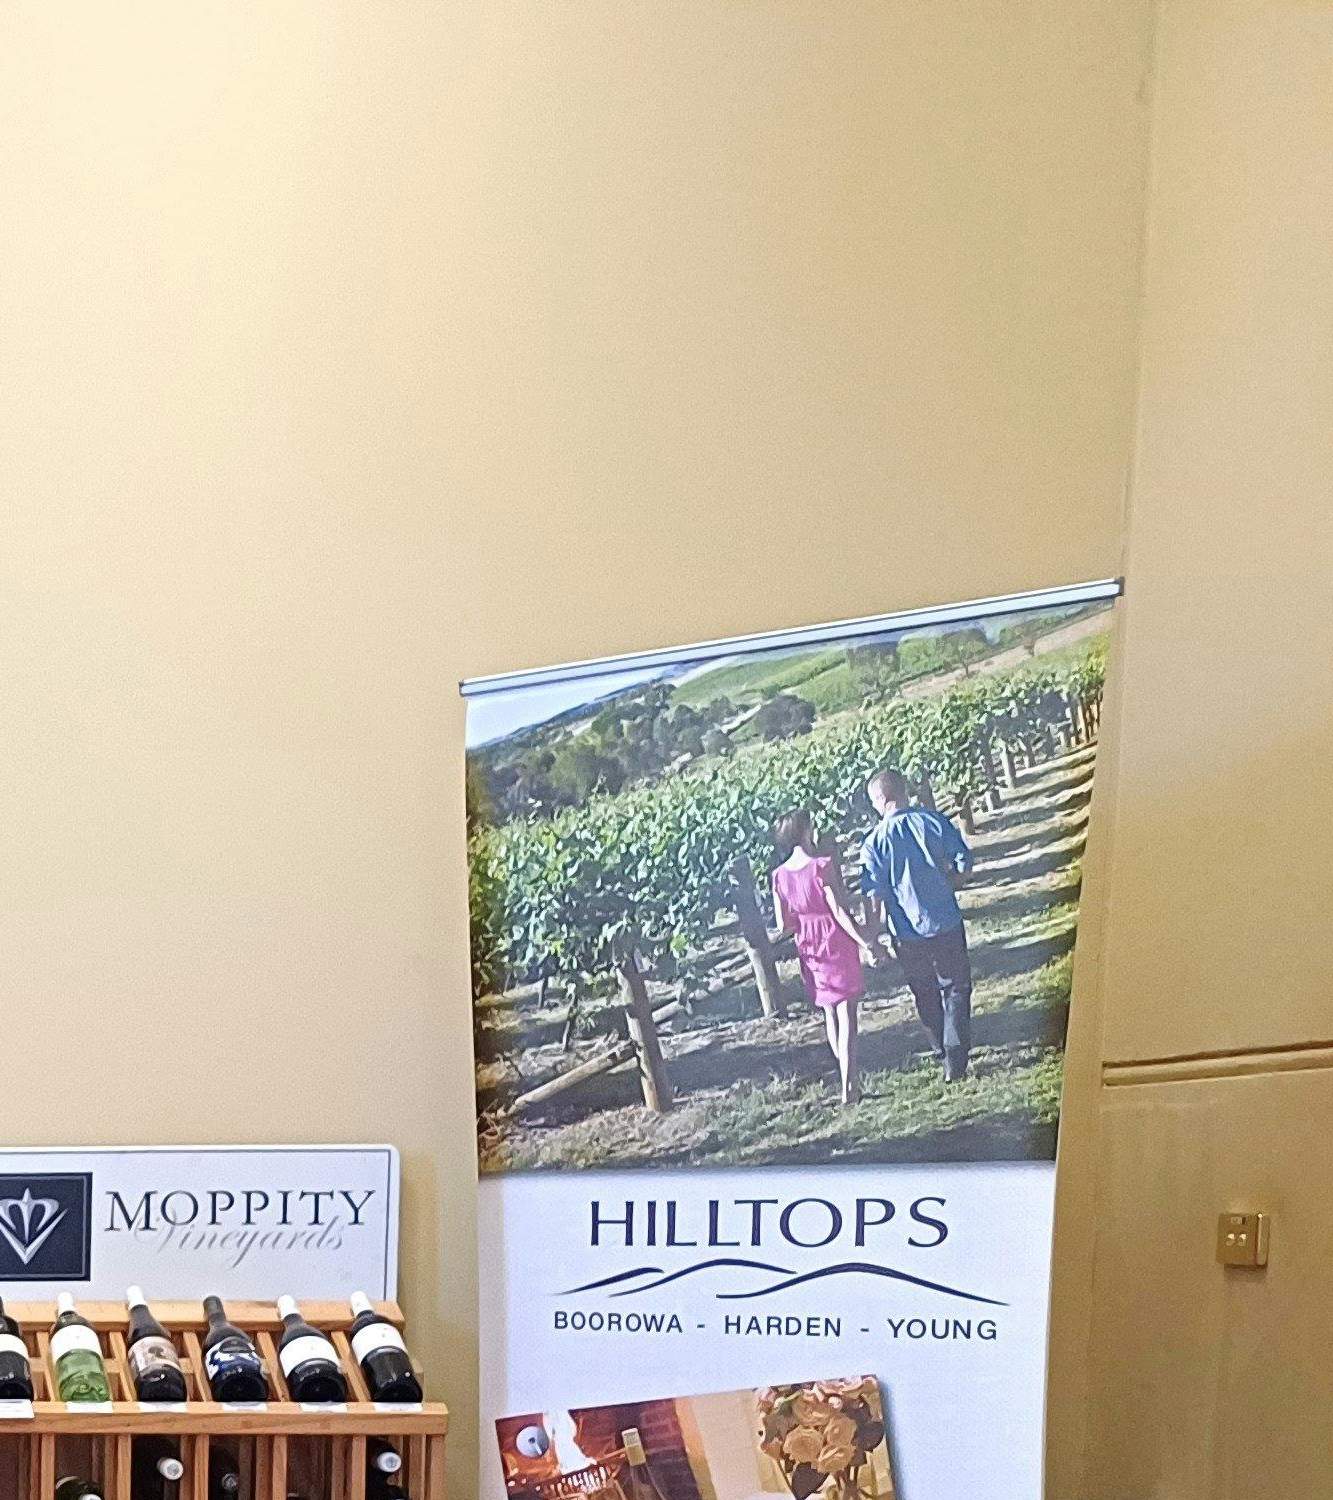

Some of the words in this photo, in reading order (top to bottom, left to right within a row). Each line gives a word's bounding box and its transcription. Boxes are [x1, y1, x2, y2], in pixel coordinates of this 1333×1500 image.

[104, 1190, 375, 1232] MOPPITY
[590, 1196, 949, 1248] HILLTOPS
[134, 1211, 347, 1267] Vineyards
[554, 1310, 683, 1334] BOOROWA
[724, 1314, 841, 1338] HARDEN
[886, 1317, 997, 1341] YOUNG
